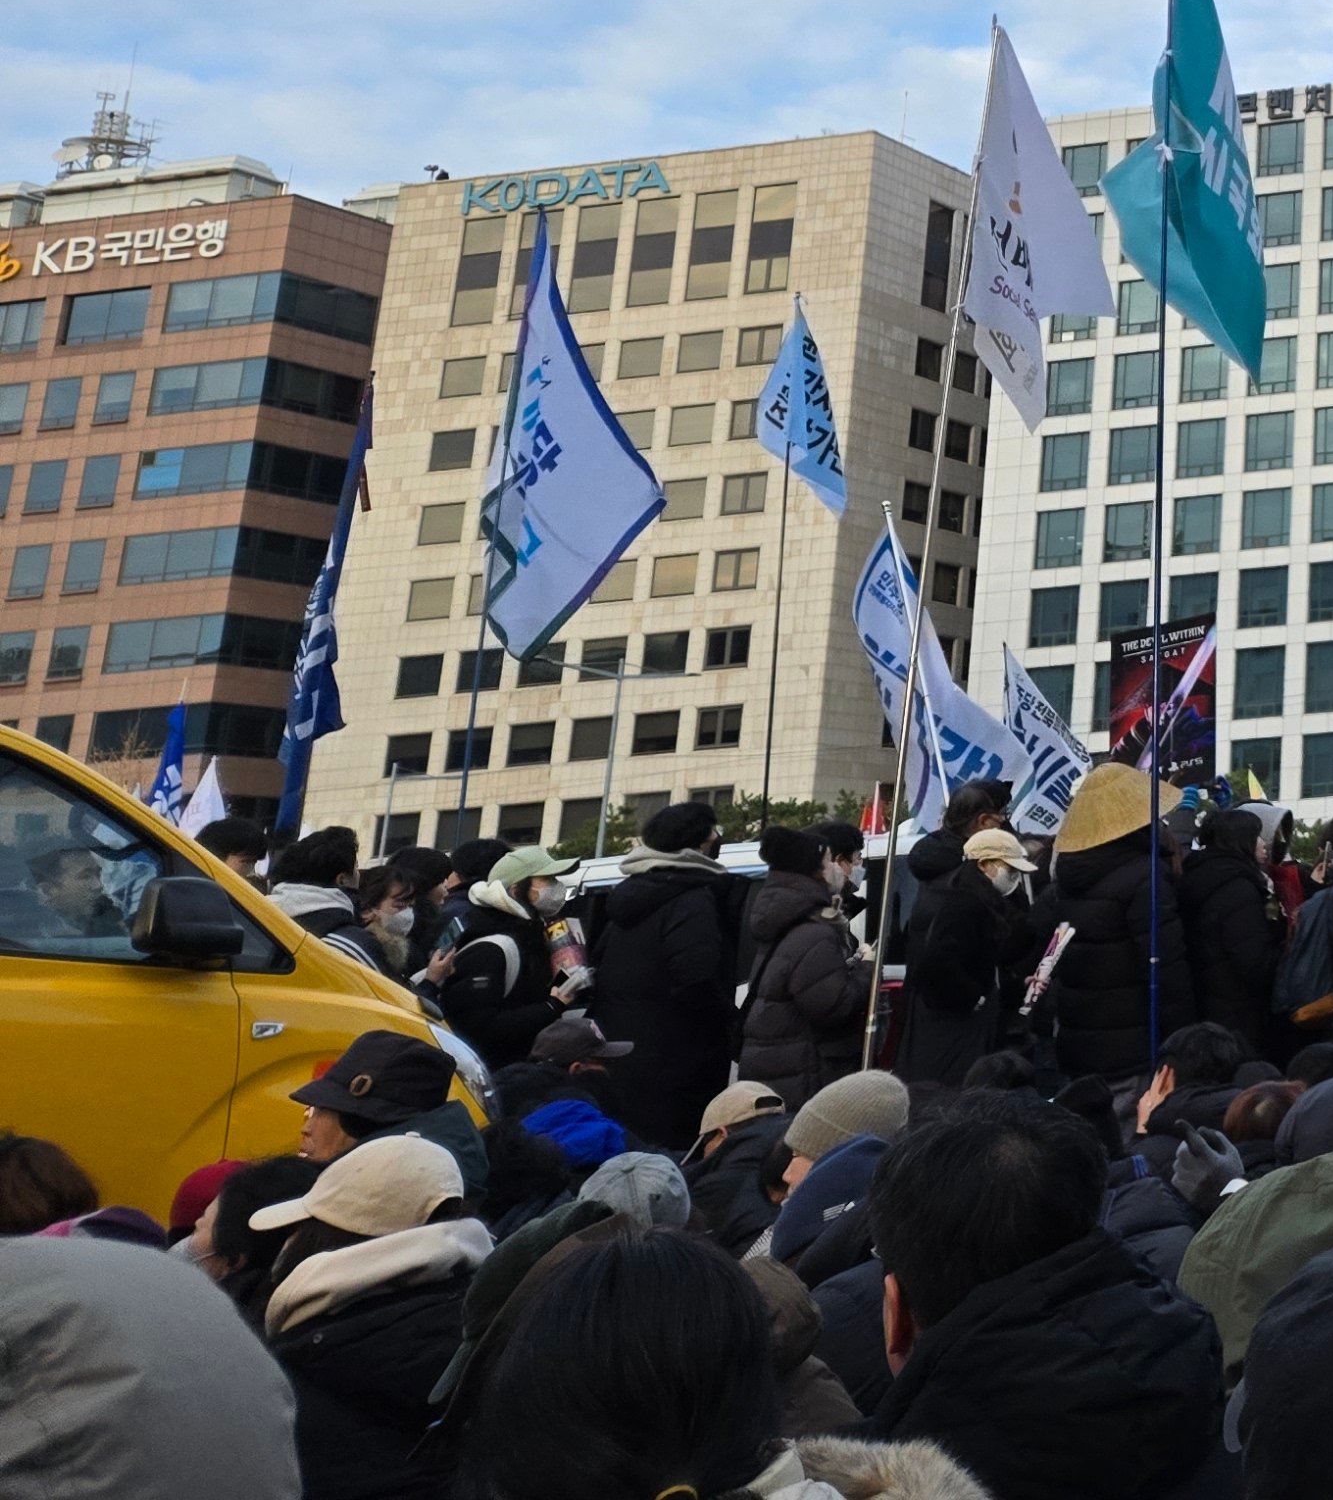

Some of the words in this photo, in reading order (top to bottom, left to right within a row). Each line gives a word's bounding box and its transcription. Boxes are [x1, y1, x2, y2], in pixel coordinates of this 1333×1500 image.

[461, 160, 671, 216] KODATA
[1121, 639, 1139, 653] THE
[1140, 633, 1168, 650] DEL
[1168, 625, 1206, 643] WITHIN
[1141, 647, 1186, 664] SAGAT
